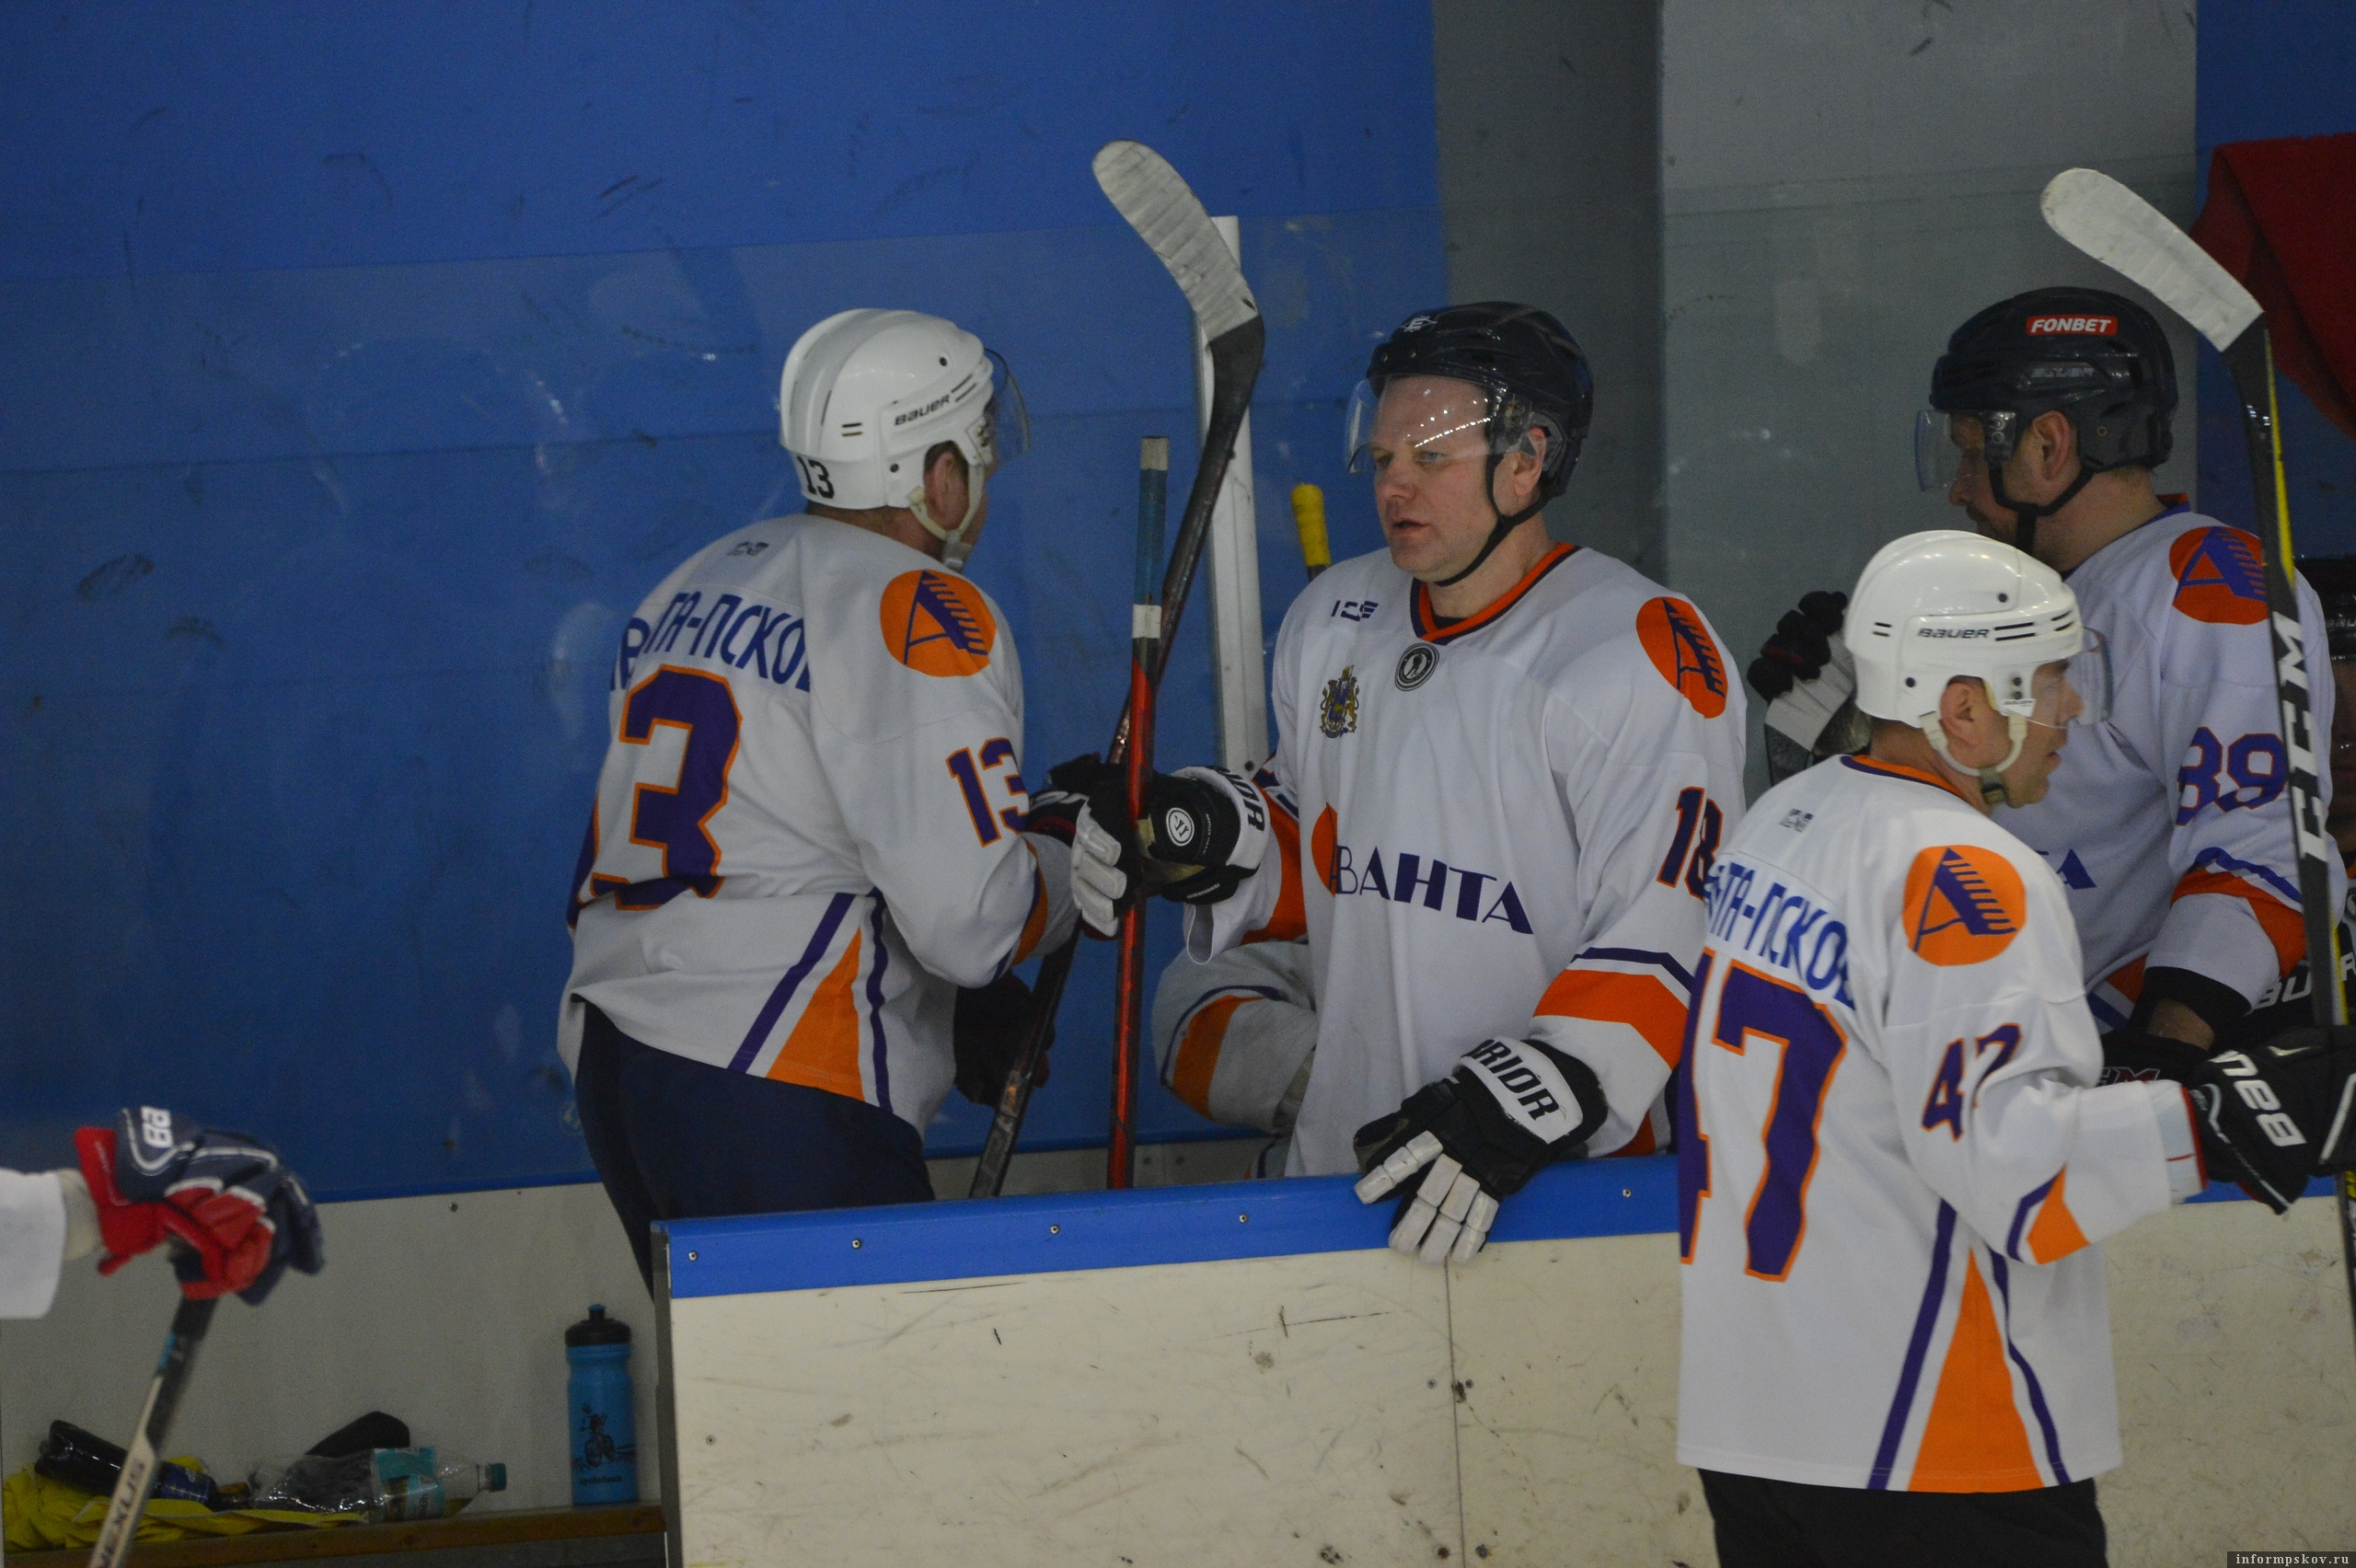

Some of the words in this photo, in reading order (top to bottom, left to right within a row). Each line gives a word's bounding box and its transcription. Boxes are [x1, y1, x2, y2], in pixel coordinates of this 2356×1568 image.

[2030, 317, 2112, 333] FONBET
[797, 455, 836, 500] 13
[2272, 610, 2328, 862] CCM
[945, 737, 1030, 848] 13
[1657, 786, 1724, 903] 18
